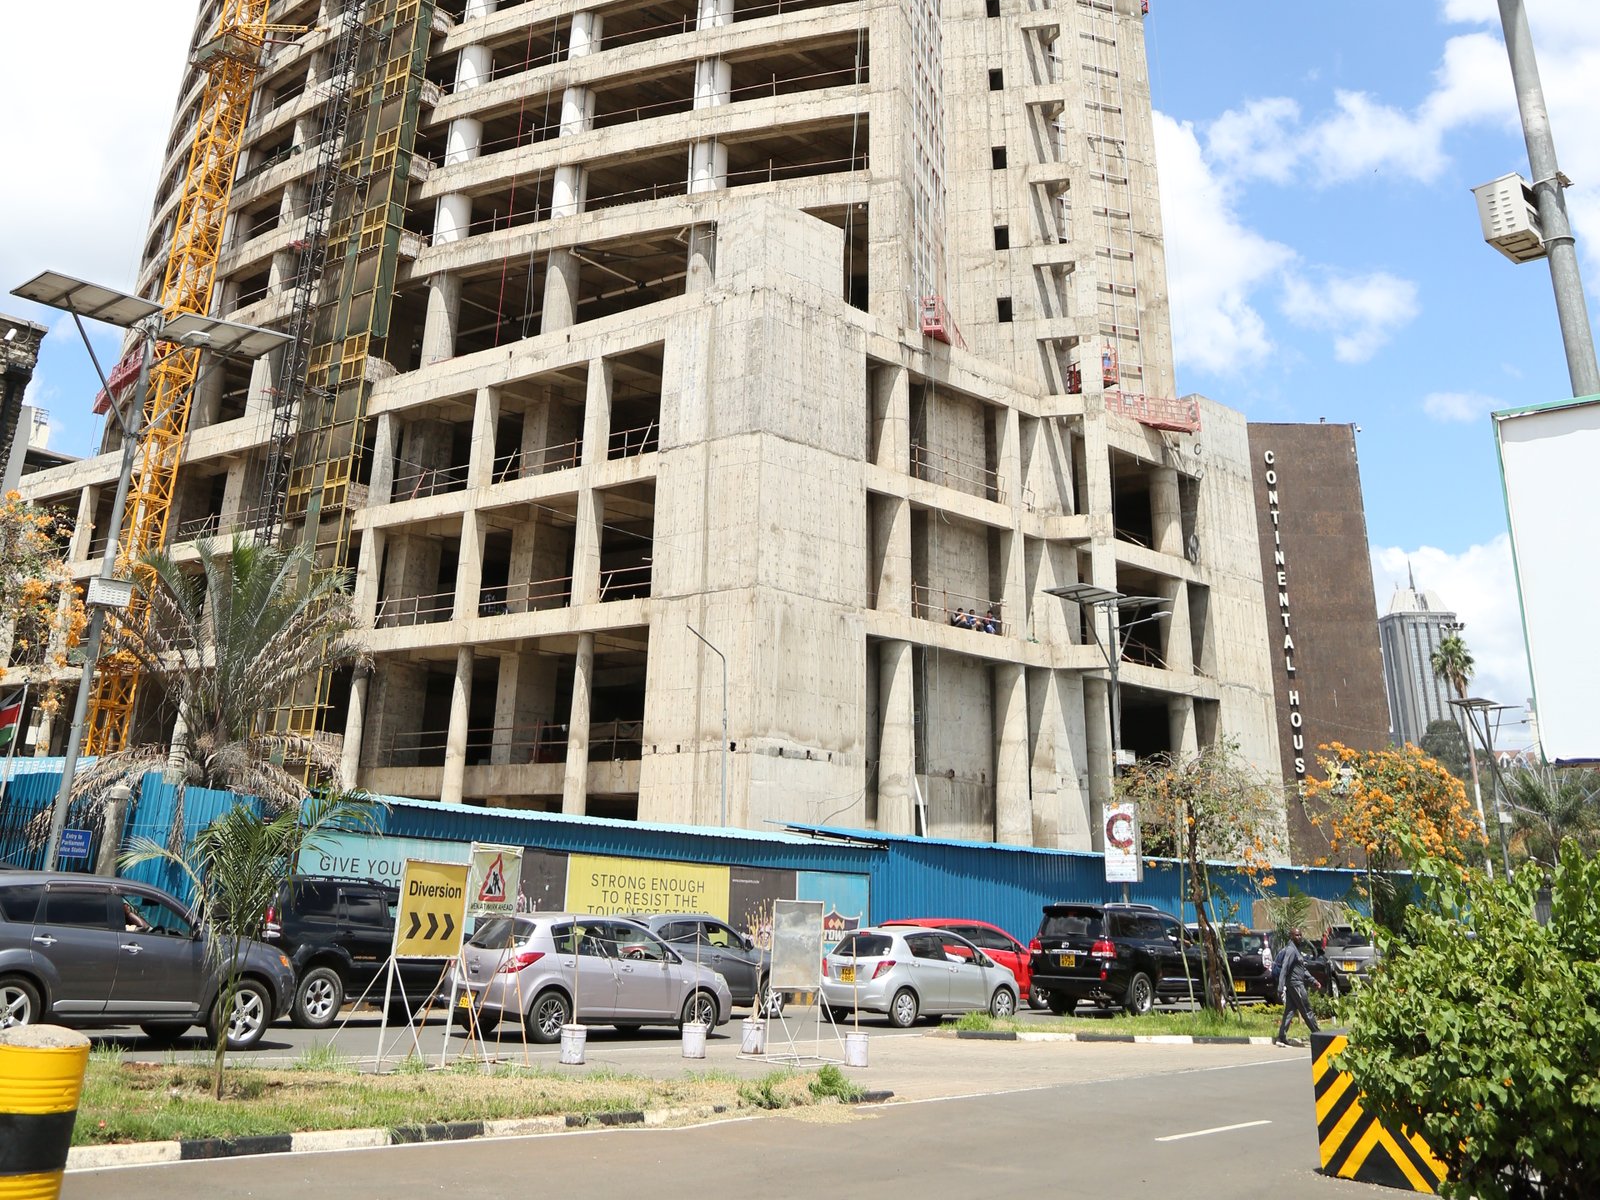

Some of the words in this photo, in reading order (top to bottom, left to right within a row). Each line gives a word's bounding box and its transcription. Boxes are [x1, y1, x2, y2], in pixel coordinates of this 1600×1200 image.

[1264, 450, 1296, 672] CONTINENTAL
[61, 839, 85, 847] Parliament
[320, 855, 361, 874] GIVE
[409, 880, 462, 899] Diversion
[591, 873, 646, 890] STRONG
[651, 877, 705, 894] ENOUGH
[602, 890, 619, 904] TO
[624, 891, 670, 907] RESIST
[675, 894, 698, 908] THE
